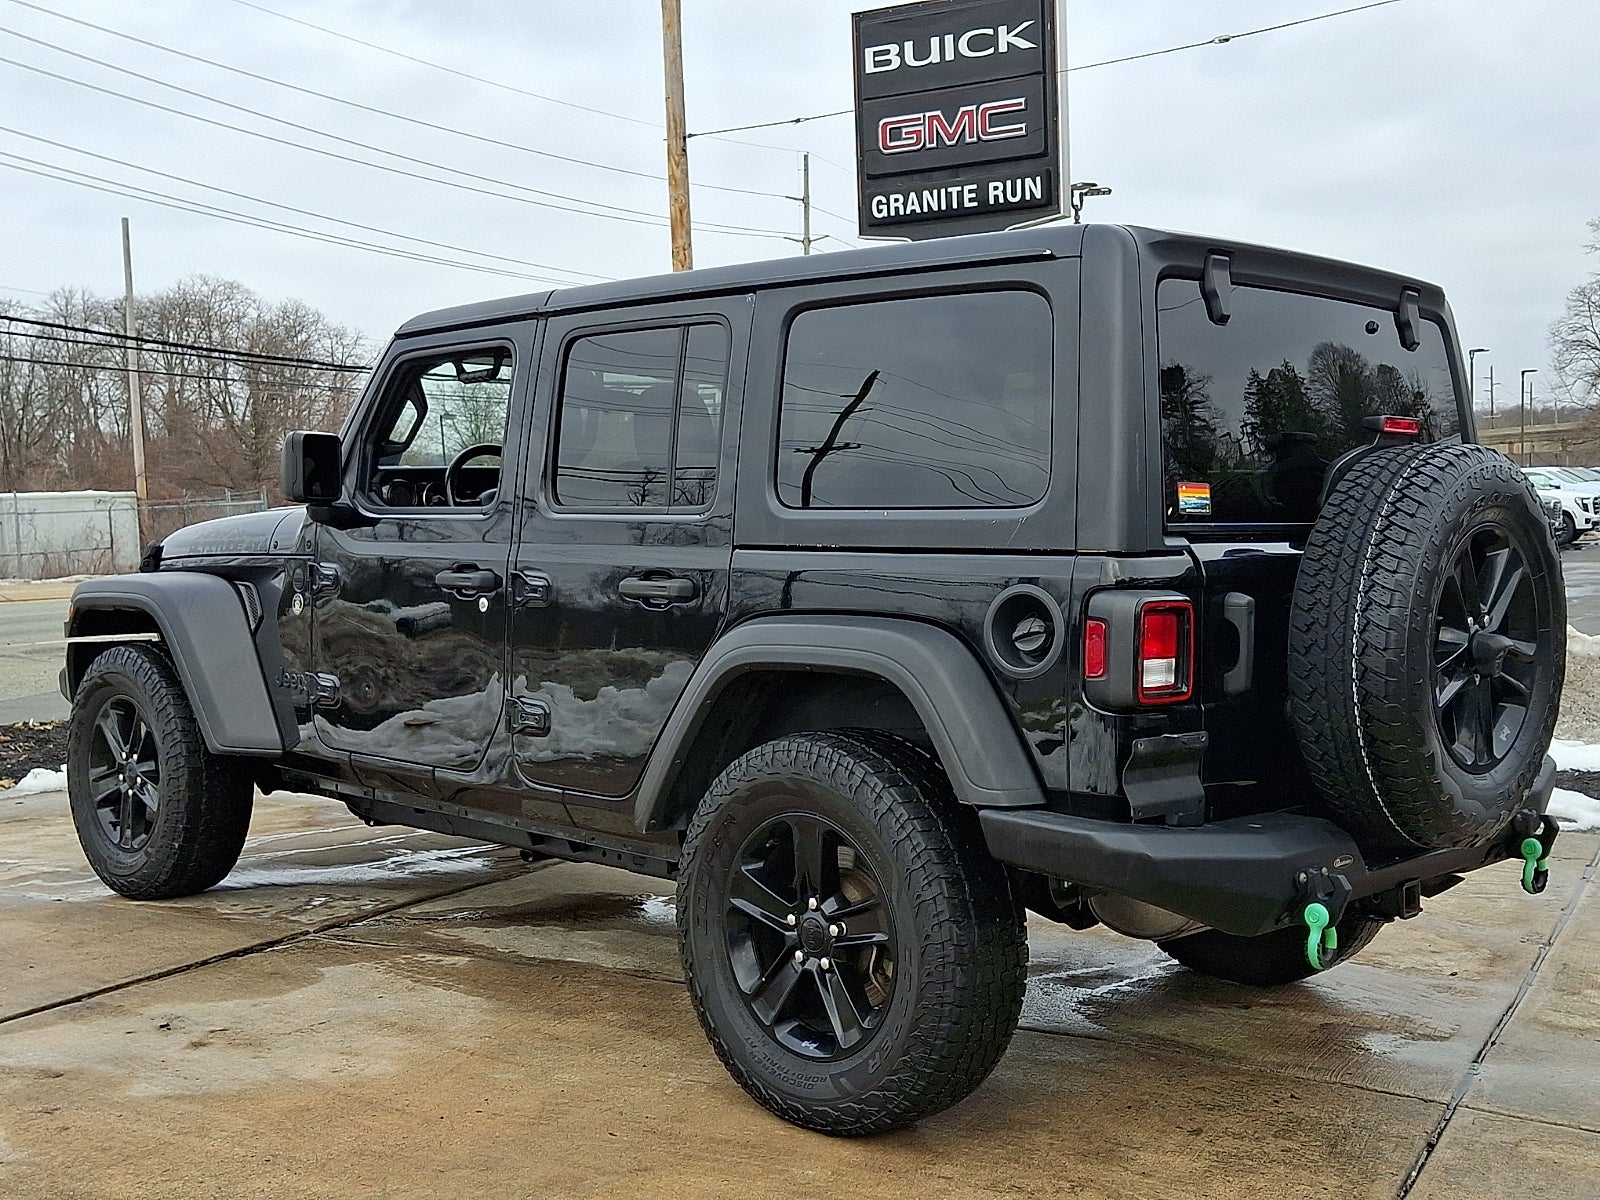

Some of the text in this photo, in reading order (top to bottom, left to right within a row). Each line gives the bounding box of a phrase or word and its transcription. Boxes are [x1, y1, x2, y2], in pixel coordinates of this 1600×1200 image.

[864, 20, 1038, 74] BUICK
[878, 97, 1027, 155] GMC
[871, 175, 1043, 219] GRANITE RUN
[275, 666, 306, 695] Jeep
